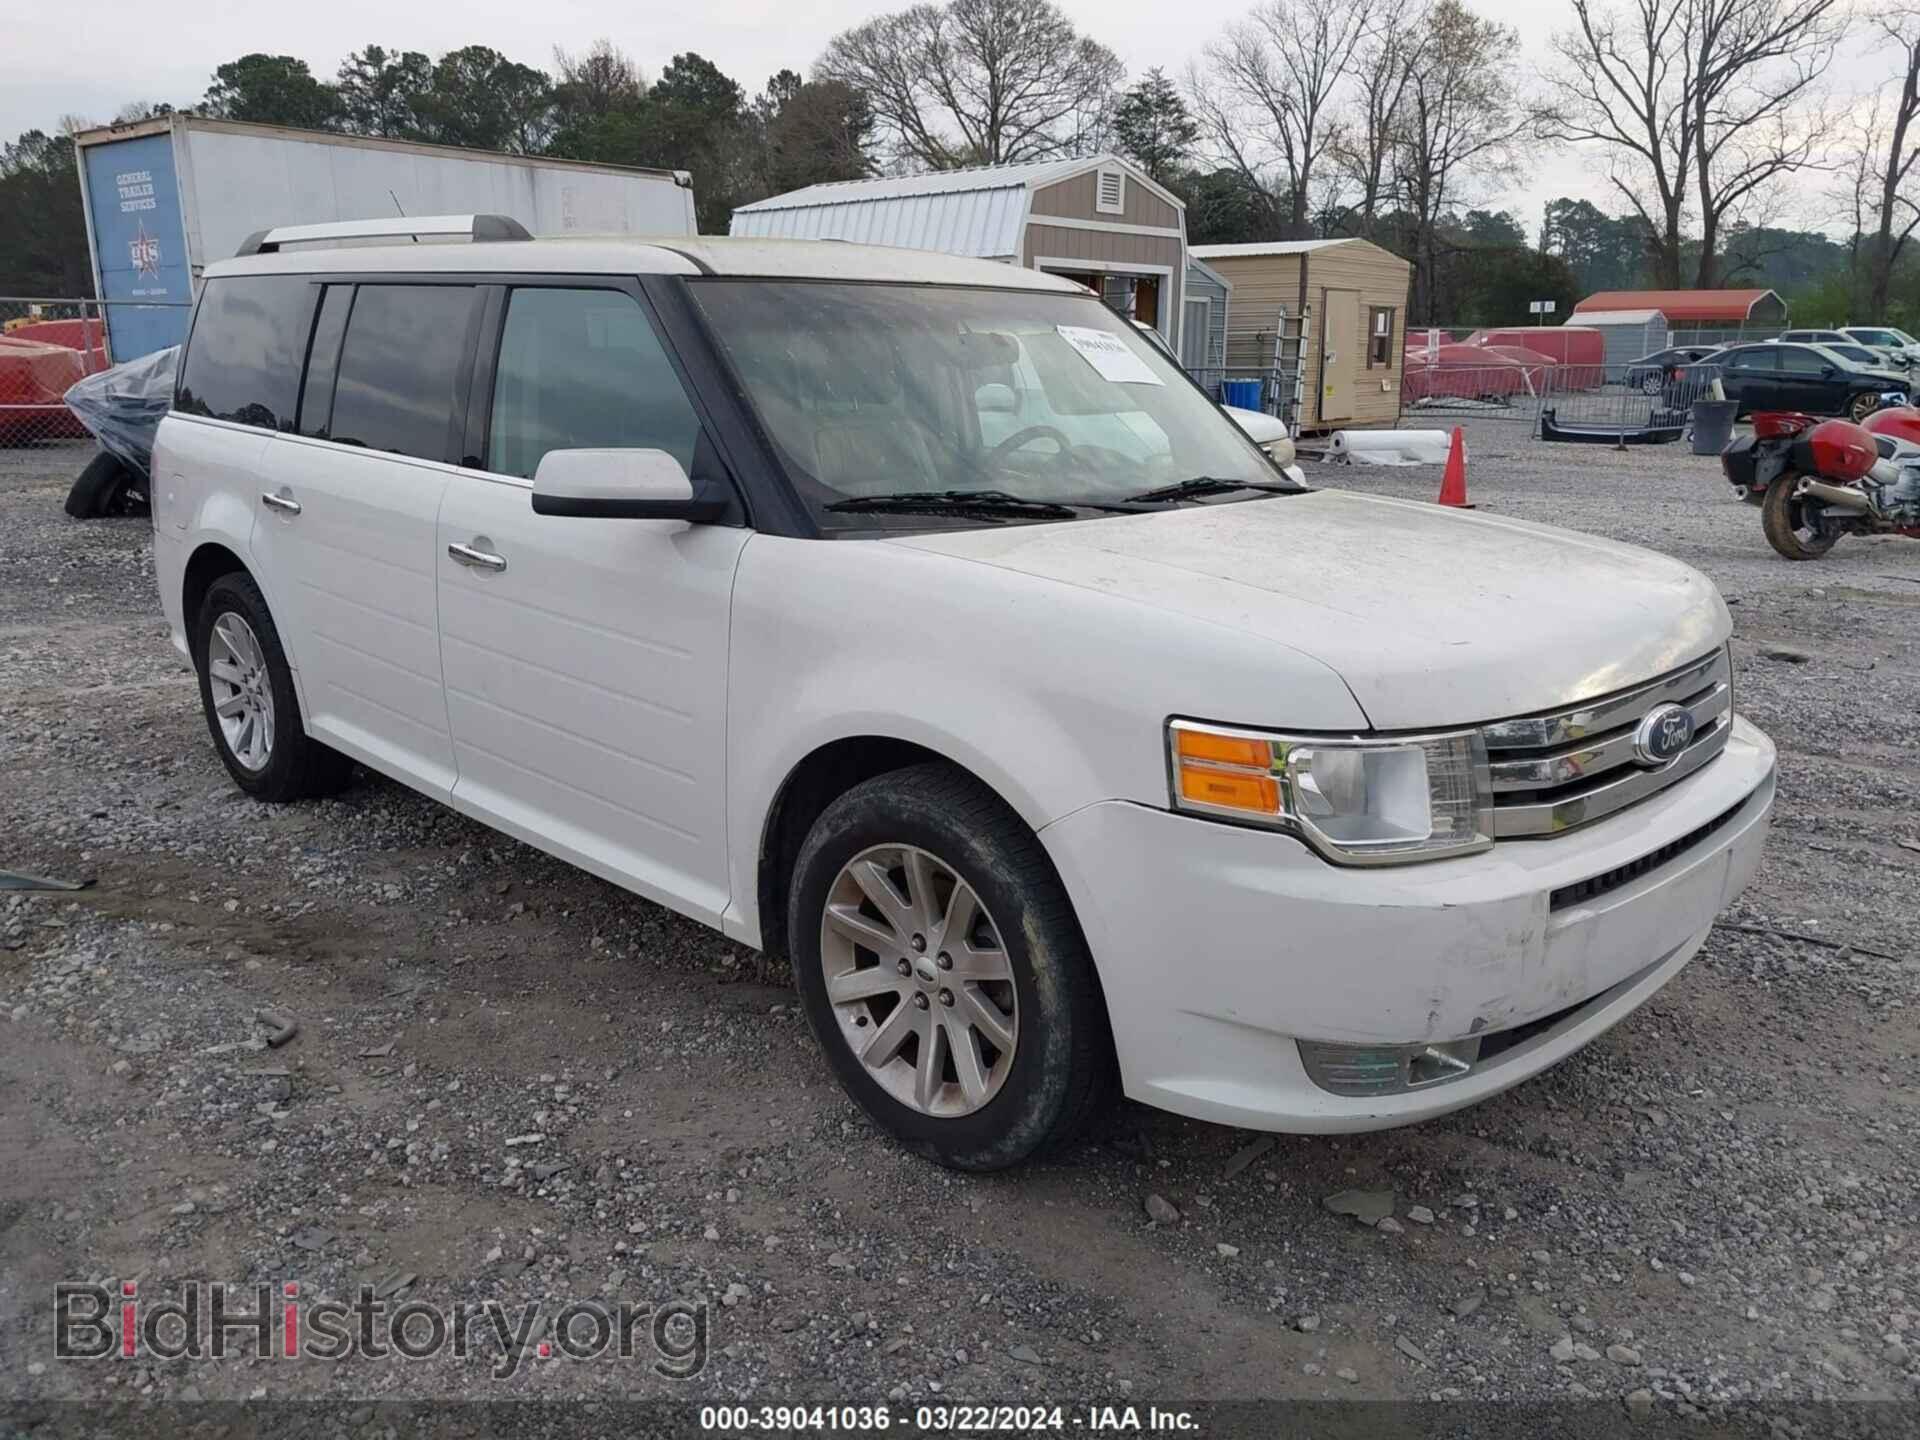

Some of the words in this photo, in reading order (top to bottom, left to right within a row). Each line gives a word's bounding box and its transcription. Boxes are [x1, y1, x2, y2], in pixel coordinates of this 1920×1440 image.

[116, 170, 153, 185] GENERAL
[118, 183, 154, 199] TRAILER
[120, 198, 156, 212] SERVICES
[1662, 715, 1688, 750] Ford
